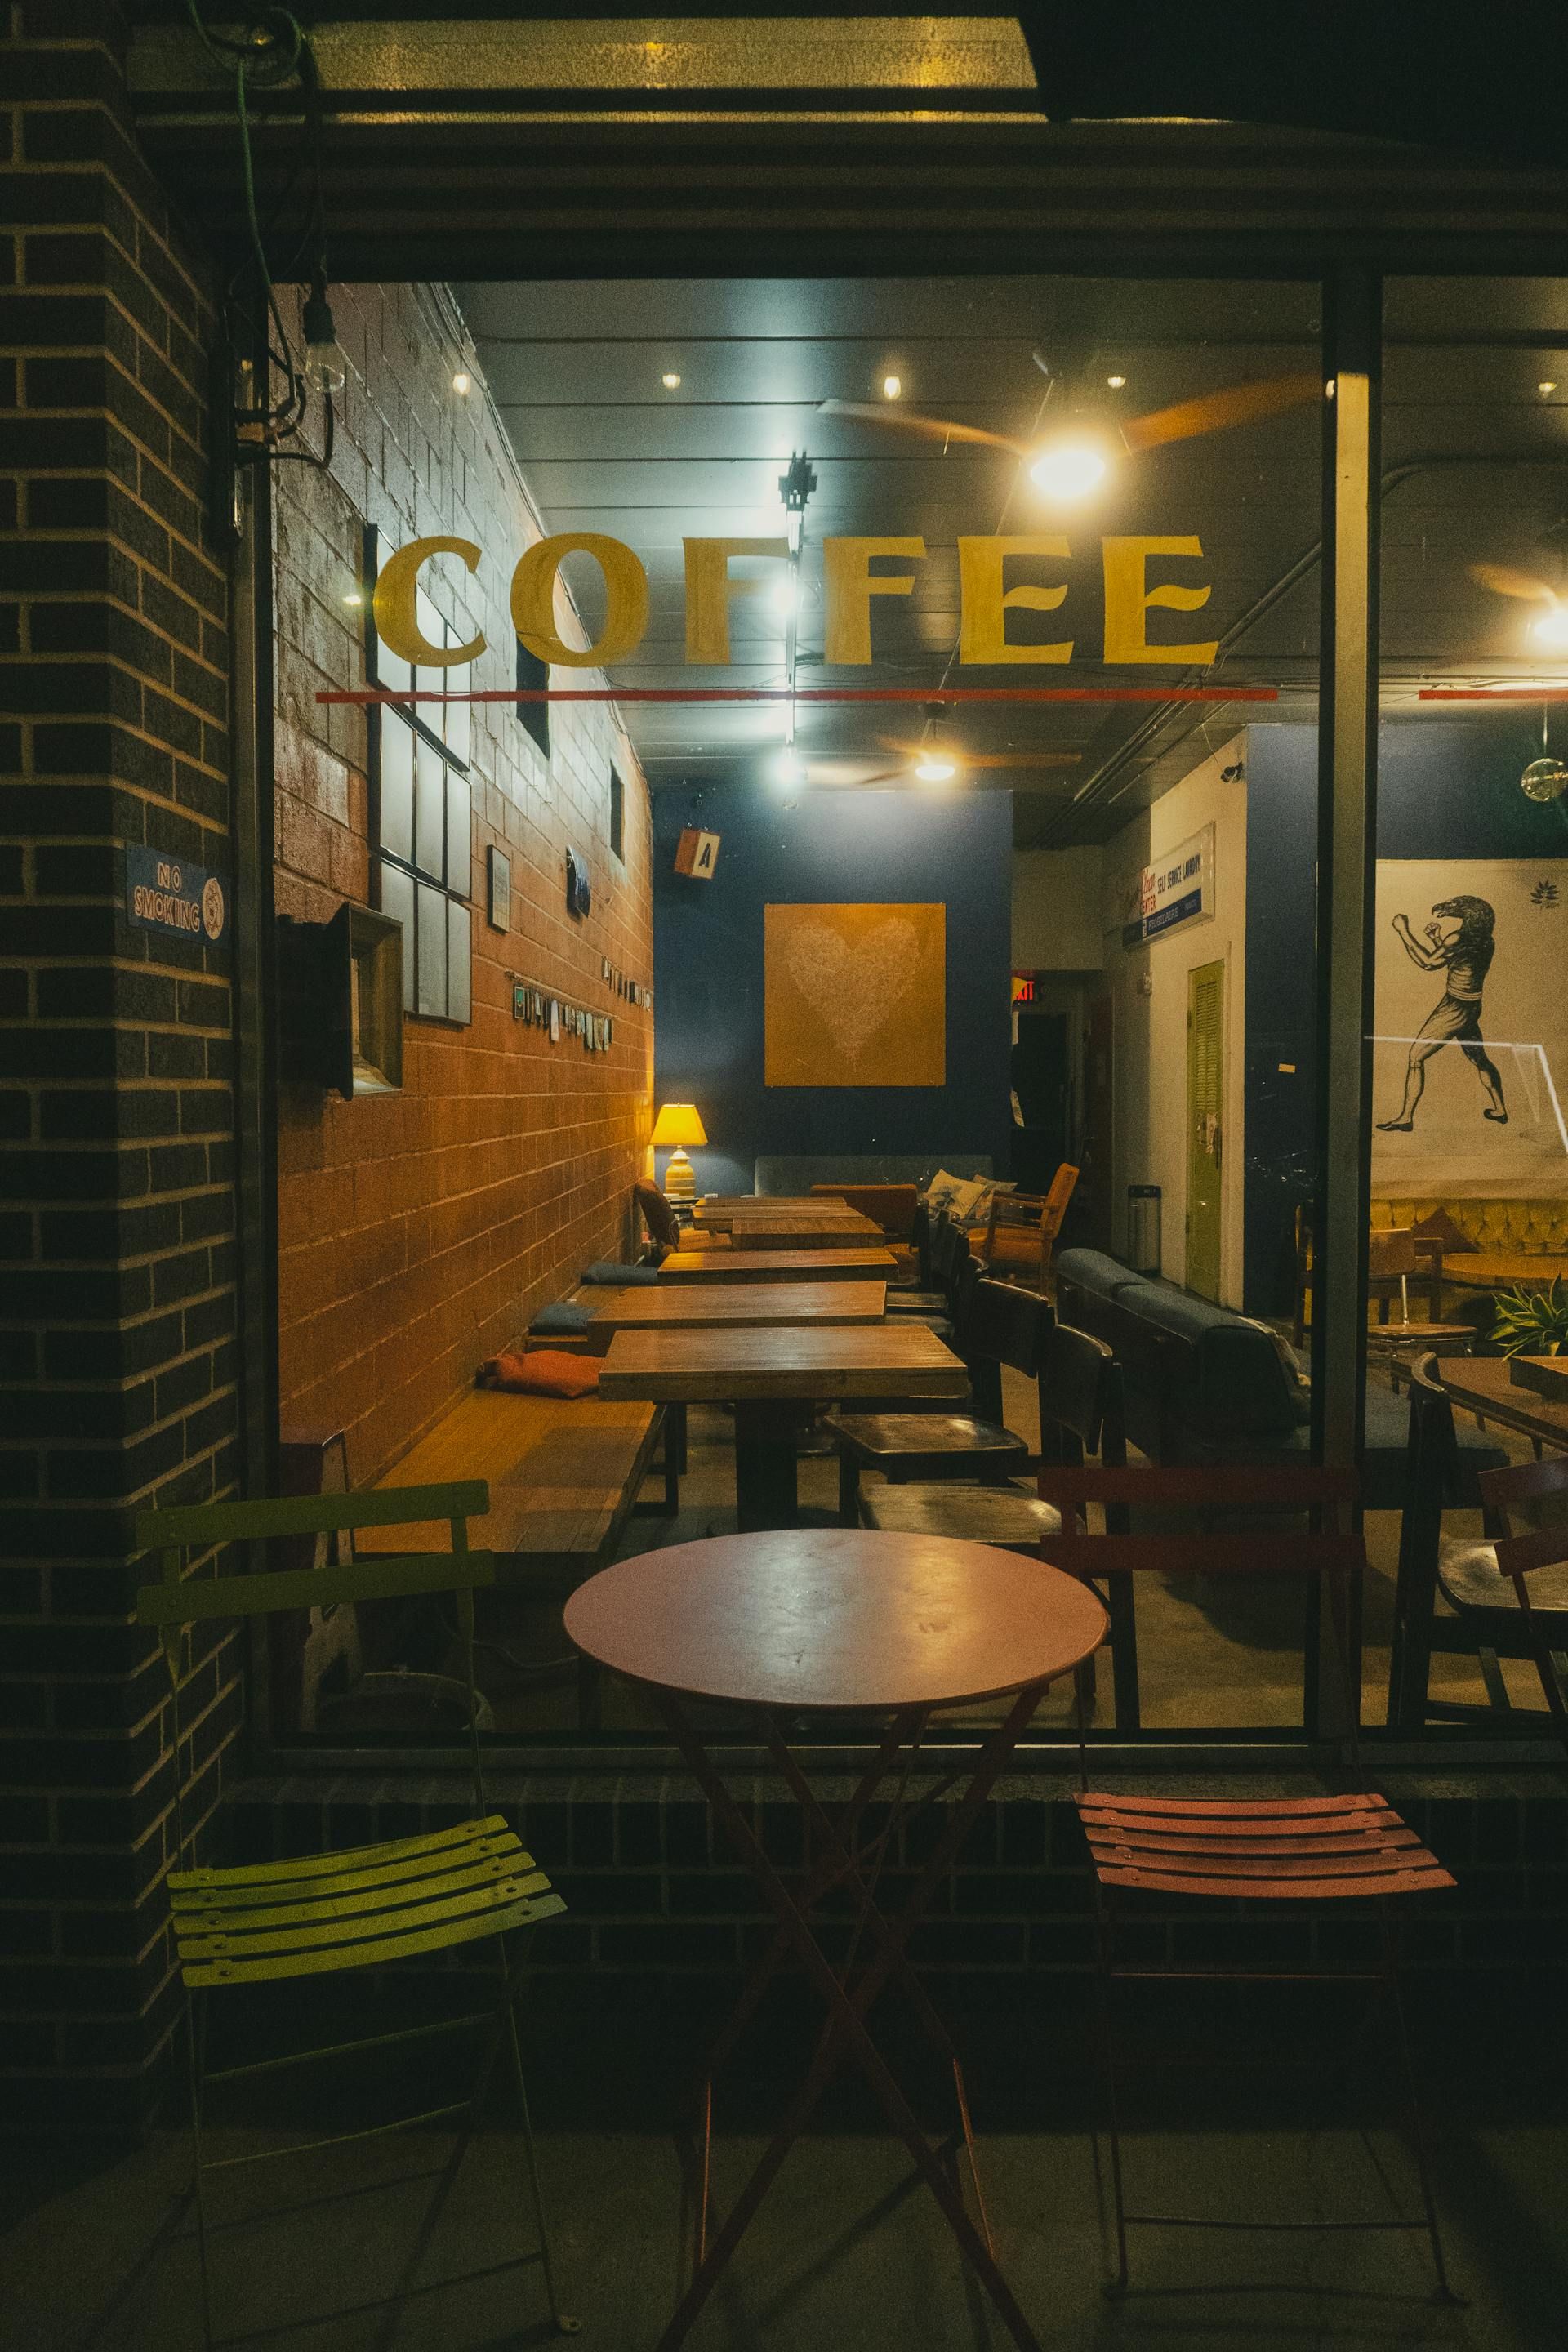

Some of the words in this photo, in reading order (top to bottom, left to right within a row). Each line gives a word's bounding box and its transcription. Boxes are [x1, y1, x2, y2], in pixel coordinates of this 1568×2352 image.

[373, 533, 1219, 667] COFFEE
[698, 843, 711, 868] A
[158, 862, 182, 893] NO
[1158, 875, 1166, 894] SELF
[1167, 866, 1182, 889] SERVICE
[134, 885, 200, 933] SMOKING
